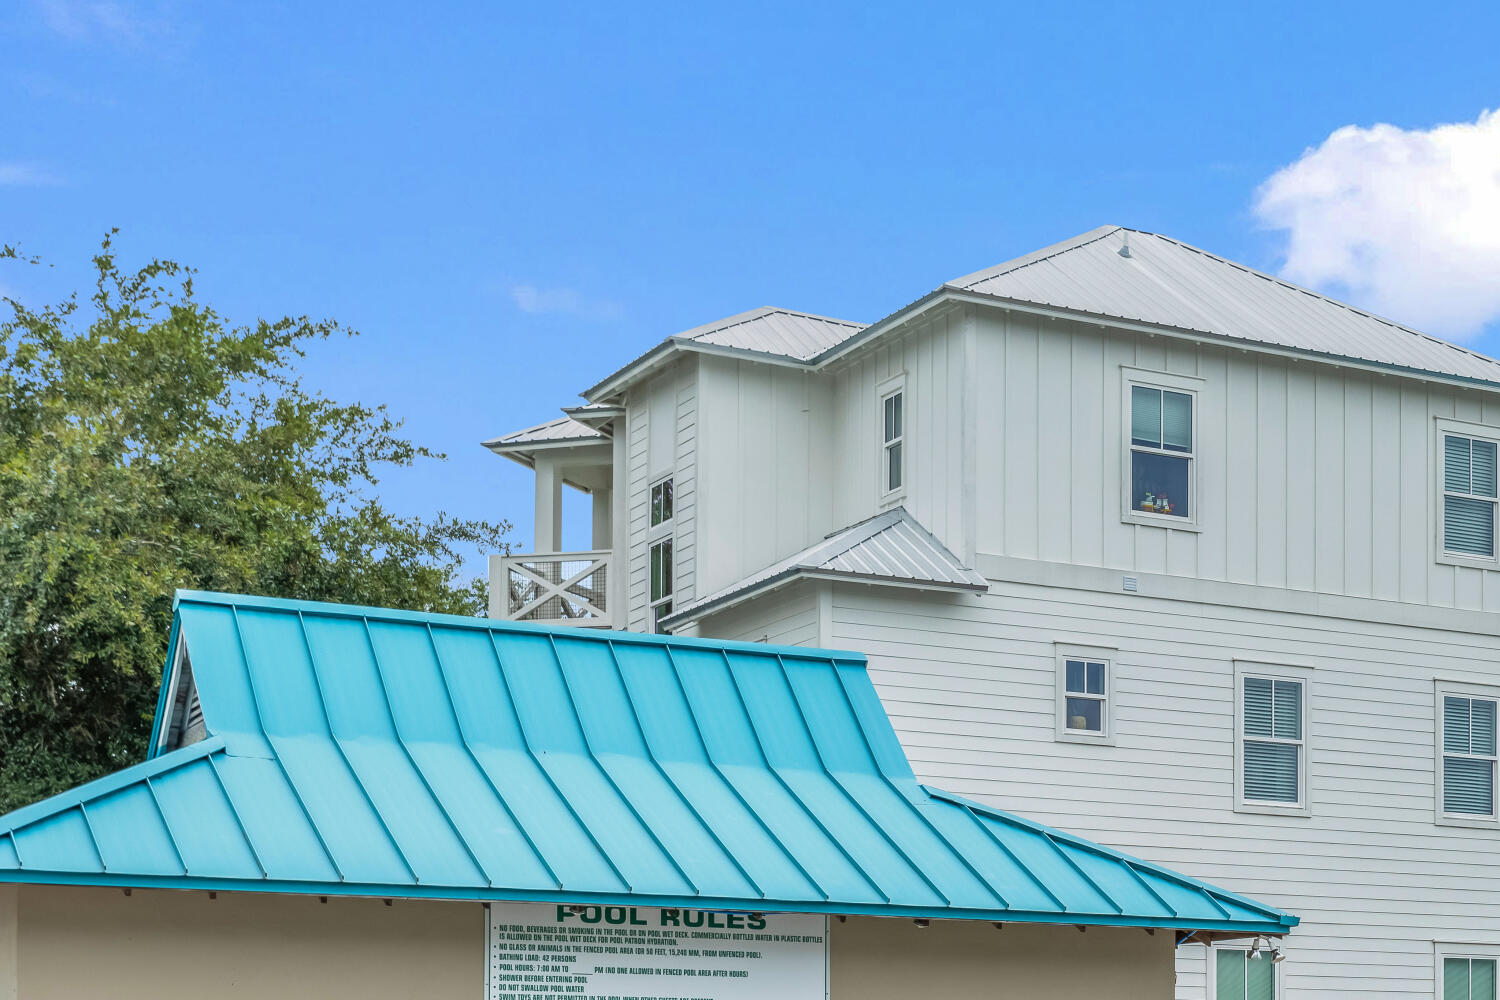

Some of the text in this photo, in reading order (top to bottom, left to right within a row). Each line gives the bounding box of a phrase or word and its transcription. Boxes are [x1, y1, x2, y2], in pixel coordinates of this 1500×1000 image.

[557, 904, 767, 930] POOL RULES
[527, 926, 557, 934] BEVERAGES
[568, 927, 594, 935] SMOKING
[648, 930, 661, 938] POOL
[675, 931, 689, 939] DECK.
[691, 932, 731, 940] COMMERCIALLY
[755, 934, 772, 942] WATER
[781, 935, 801, 943] PLASTIC
[537, 944, 562, 952] ANIMALS
[655, 948, 667, 956] FEET,
[719, 950, 744, 958] UNFENCED
[525, 954, 540, 962] LOAD:
[524, 975, 544, 983] BEFORE
[521, 984, 549, 992] SWALLOW
[566, 985, 584, 993] WATER
